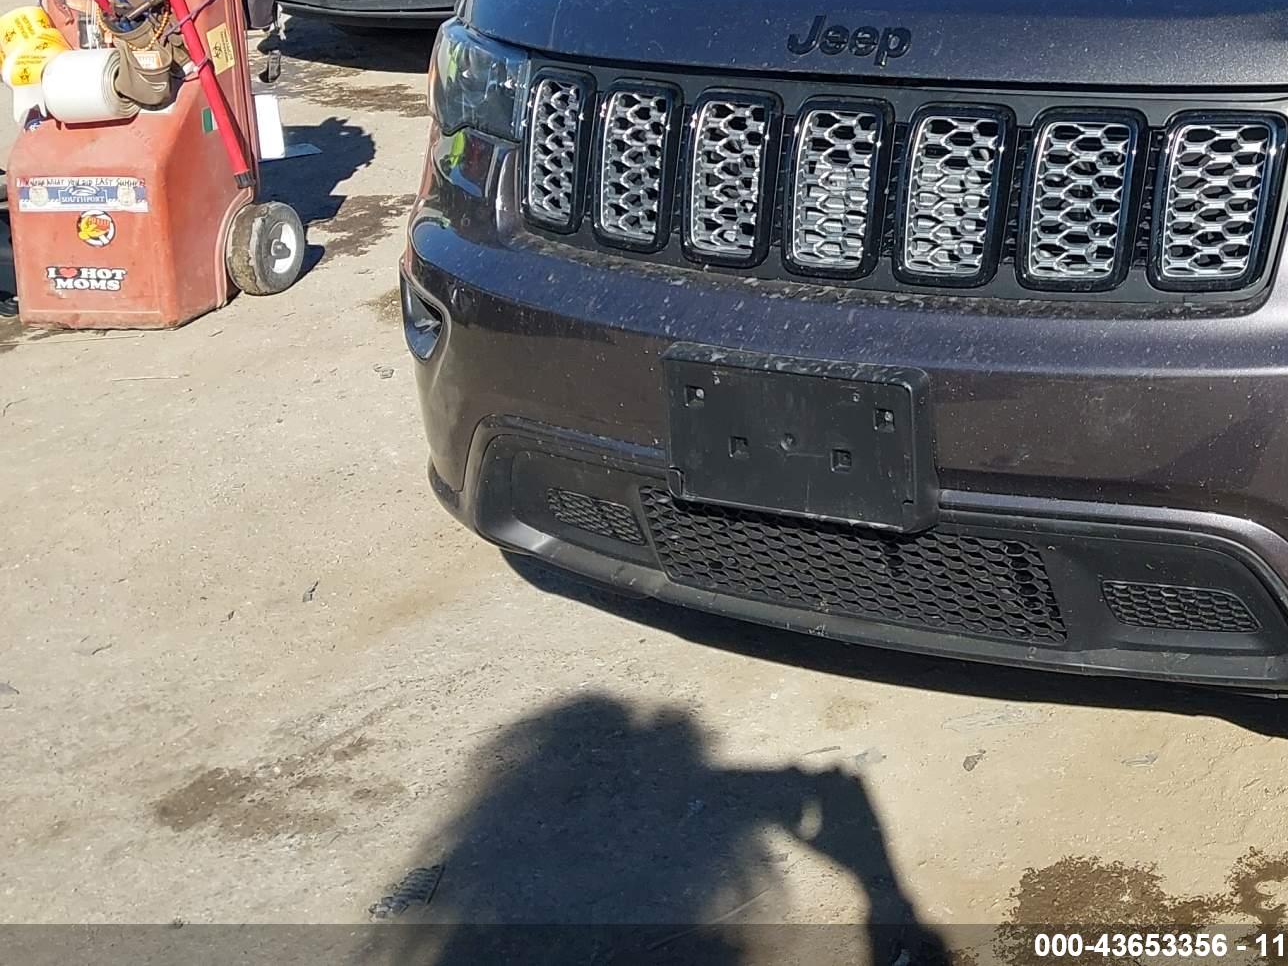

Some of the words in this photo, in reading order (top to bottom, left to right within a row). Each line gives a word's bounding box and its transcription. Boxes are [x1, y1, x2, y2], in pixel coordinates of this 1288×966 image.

[787, 14, 912, 67] Jeep
[47, 178, 65, 187] WHAT
[95, 178, 113, 187] LAST
[47, 267, 57, 278] I
[79, 267, 126, 280] HOT
[55, 278, 121, 291] MOMS
